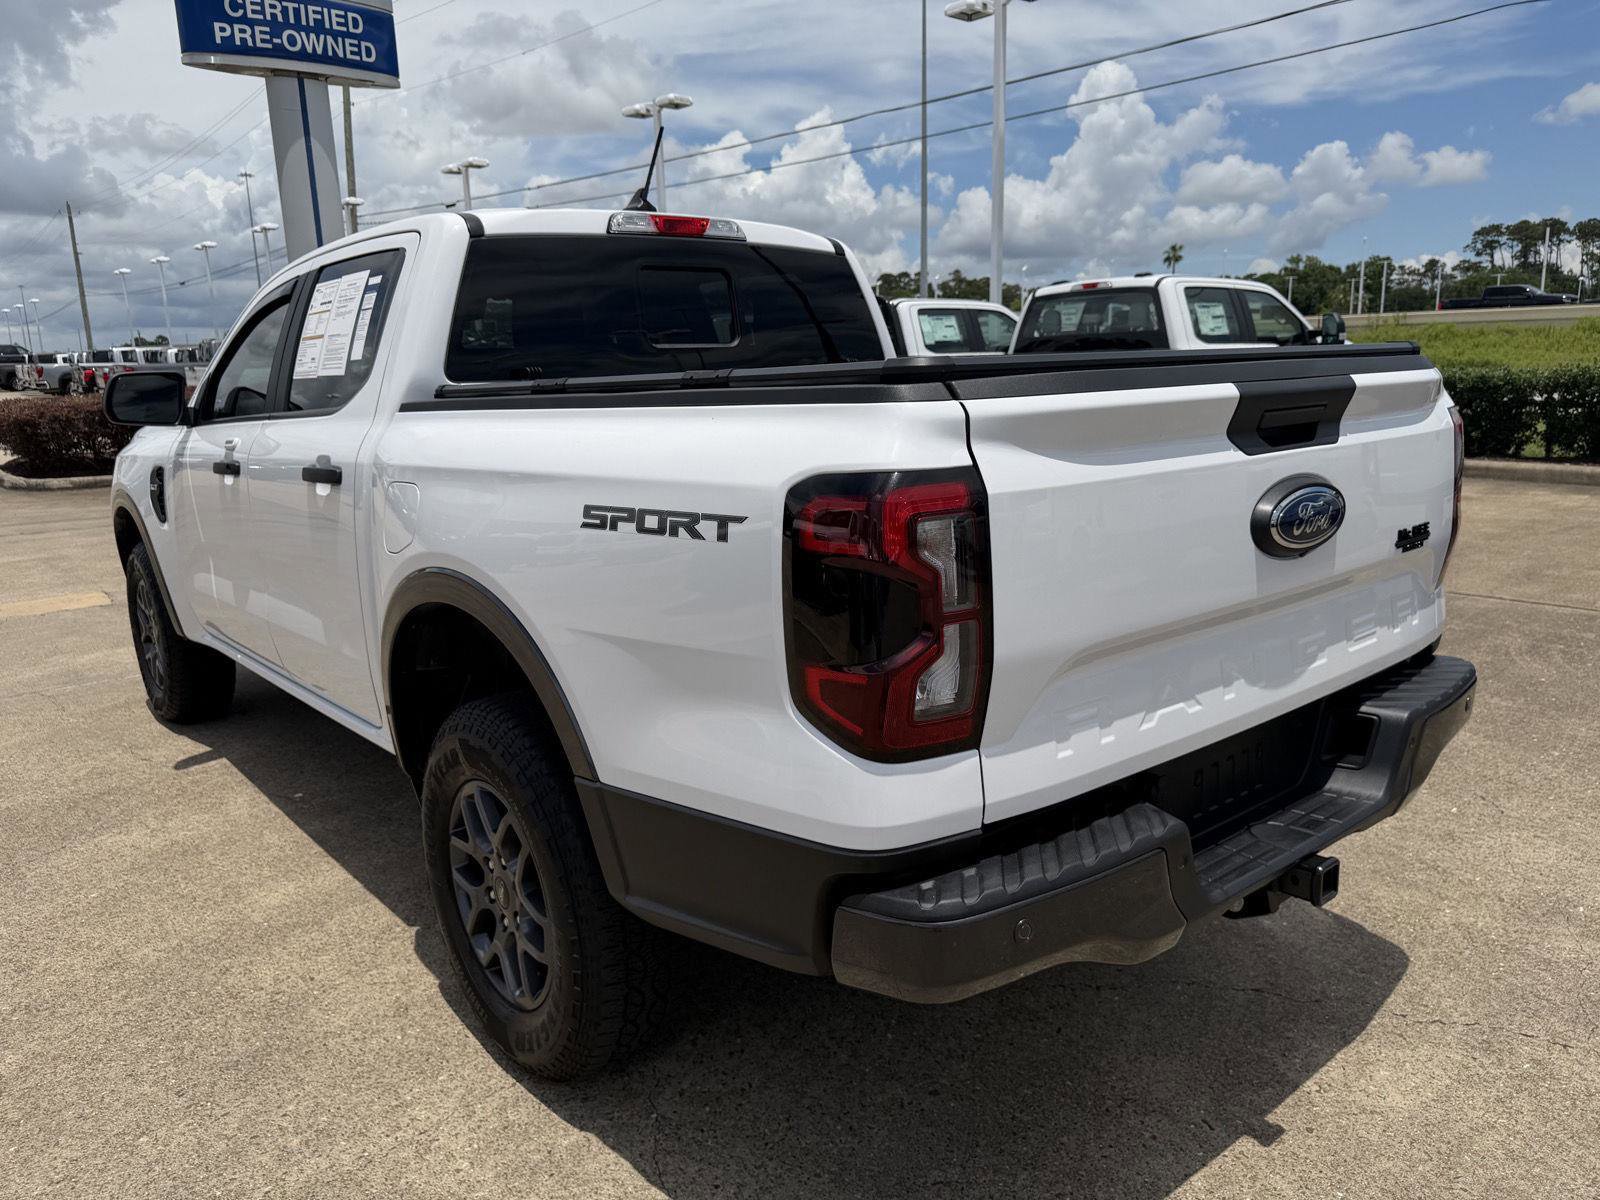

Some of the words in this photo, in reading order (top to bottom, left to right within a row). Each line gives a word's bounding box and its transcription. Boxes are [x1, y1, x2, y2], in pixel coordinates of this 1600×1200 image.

[224, 0, 364, 34] CERTIFIED
[213, 21, 377, 63] PRE-OWNED
[580, 503, 749, 543] SPORT
[1293, 500, 1332, 536] Ford
